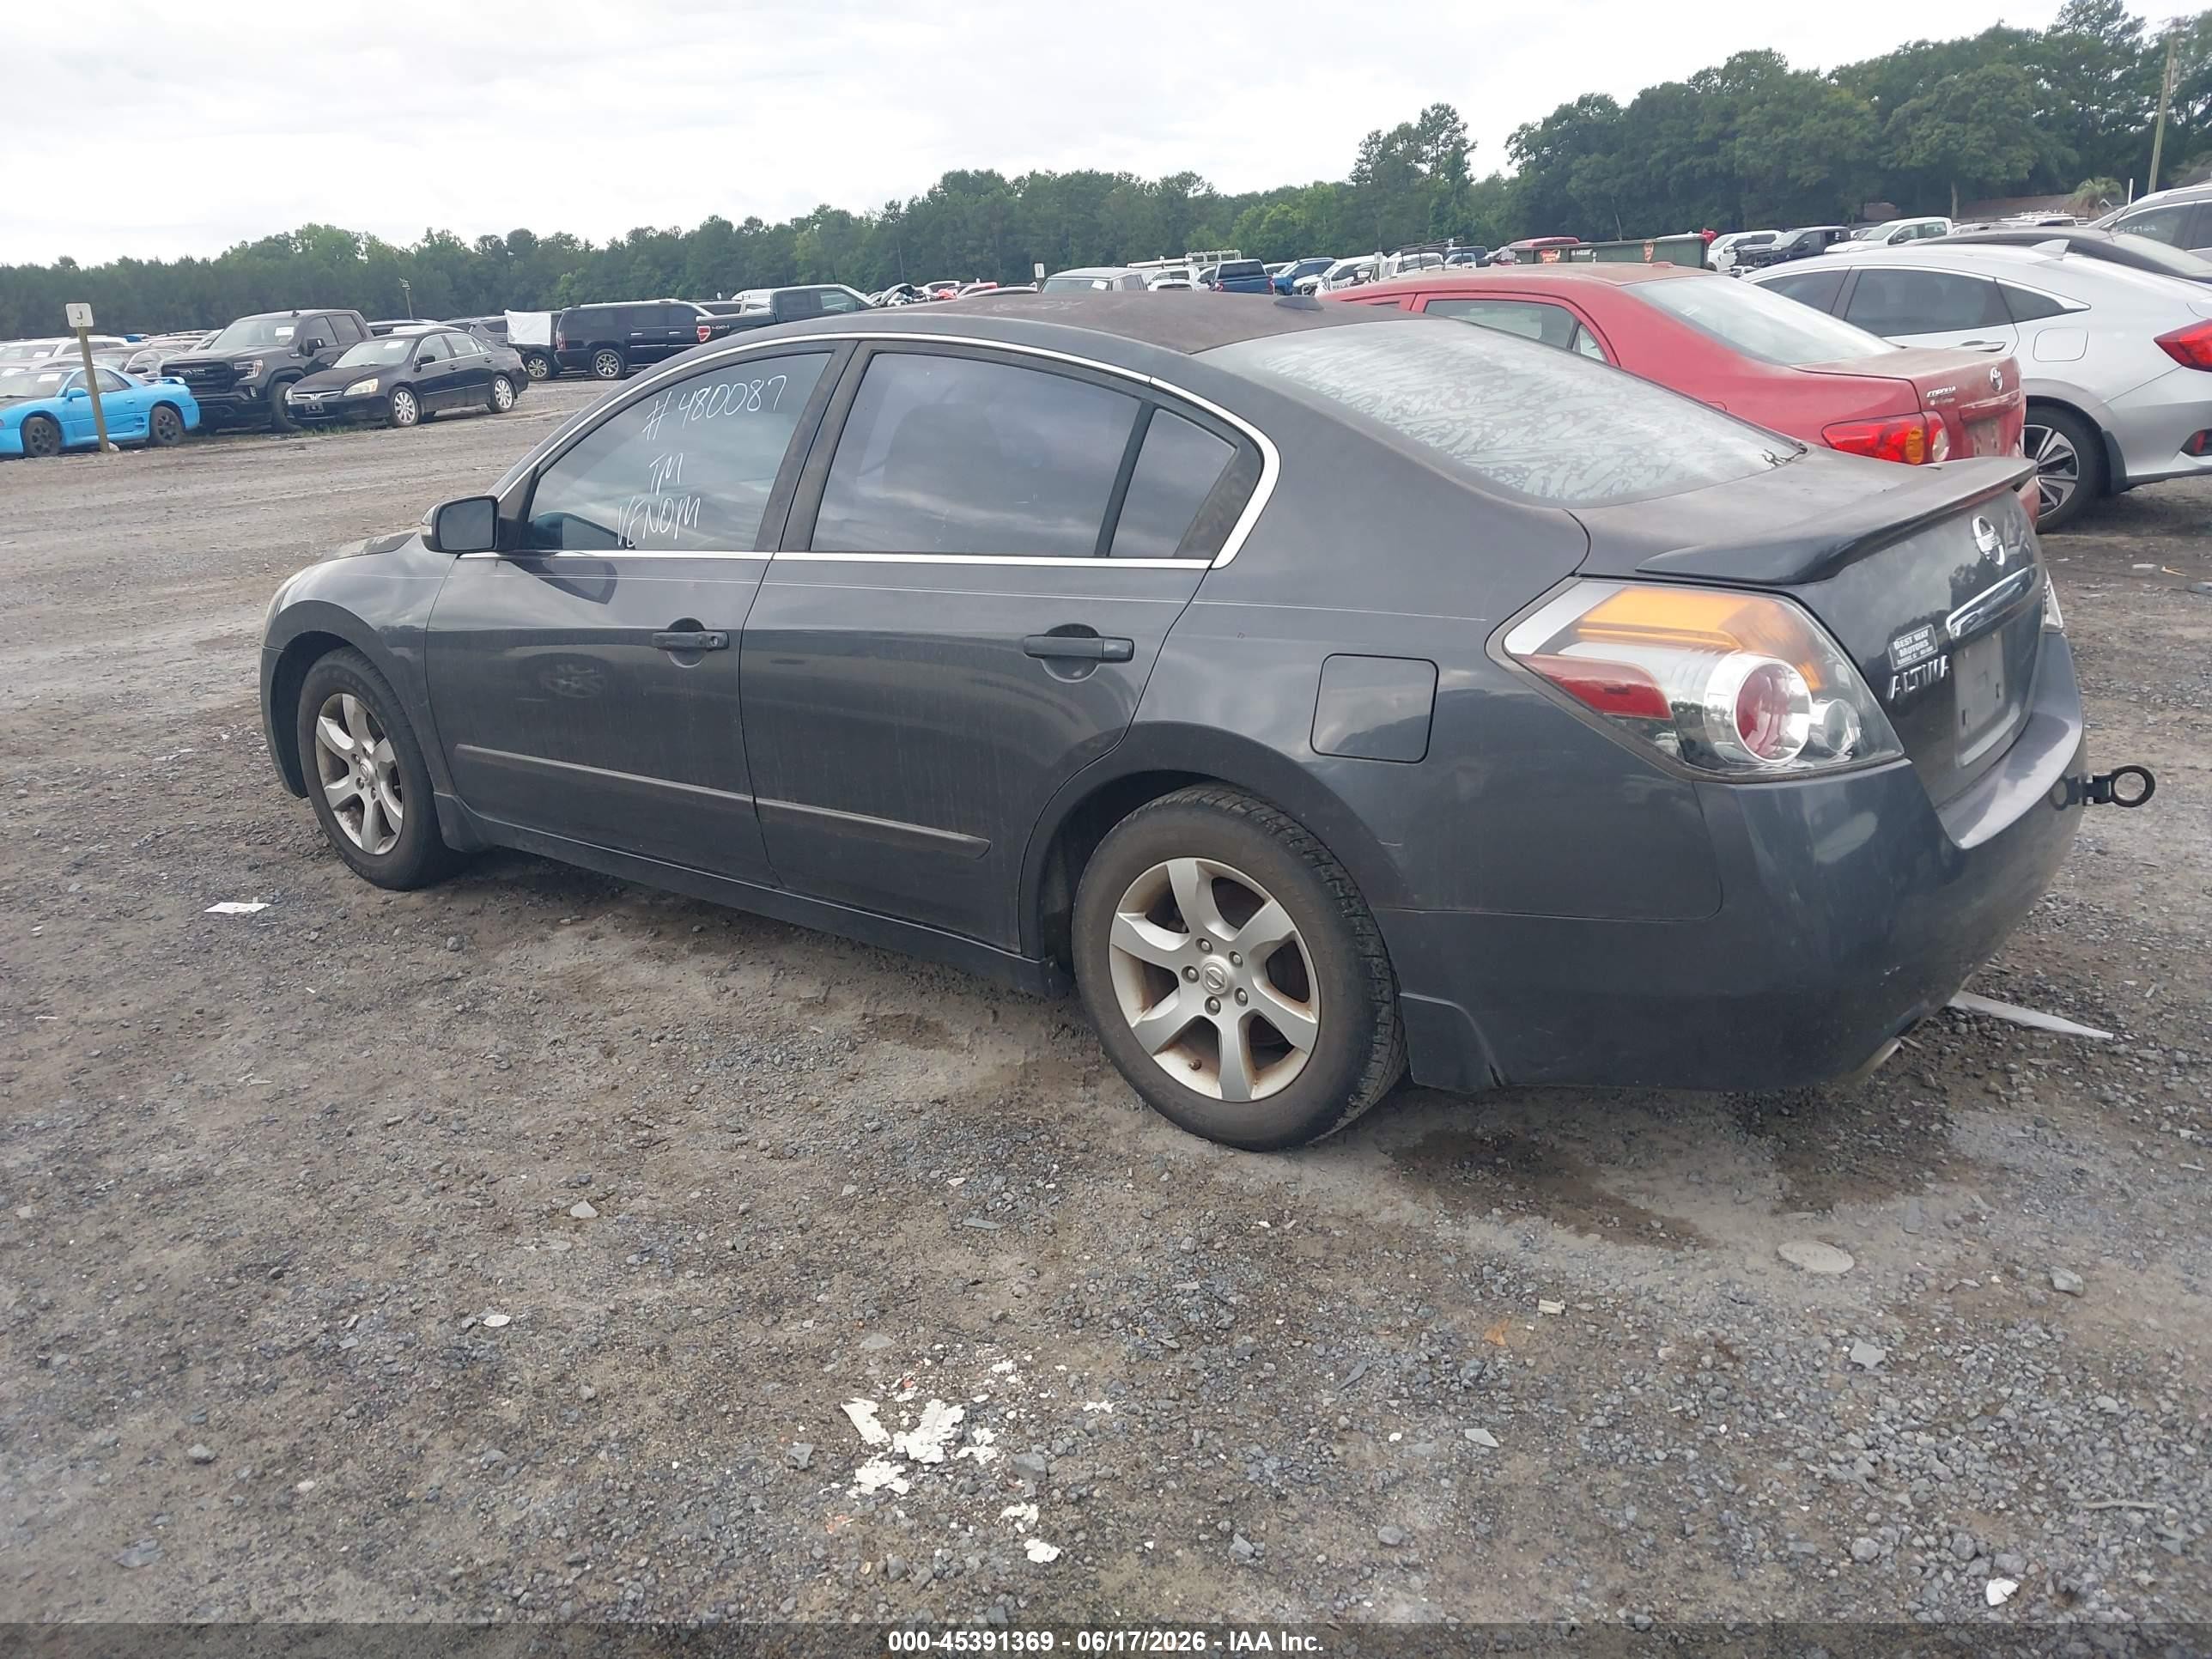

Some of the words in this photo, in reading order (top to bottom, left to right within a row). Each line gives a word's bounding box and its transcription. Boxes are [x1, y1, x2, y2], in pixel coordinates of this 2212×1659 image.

[617, 495, 701, 548] VENOM
[1893, 635, 1913, 651] BEST
[1899, 639, 1929, 658] MOTORS
